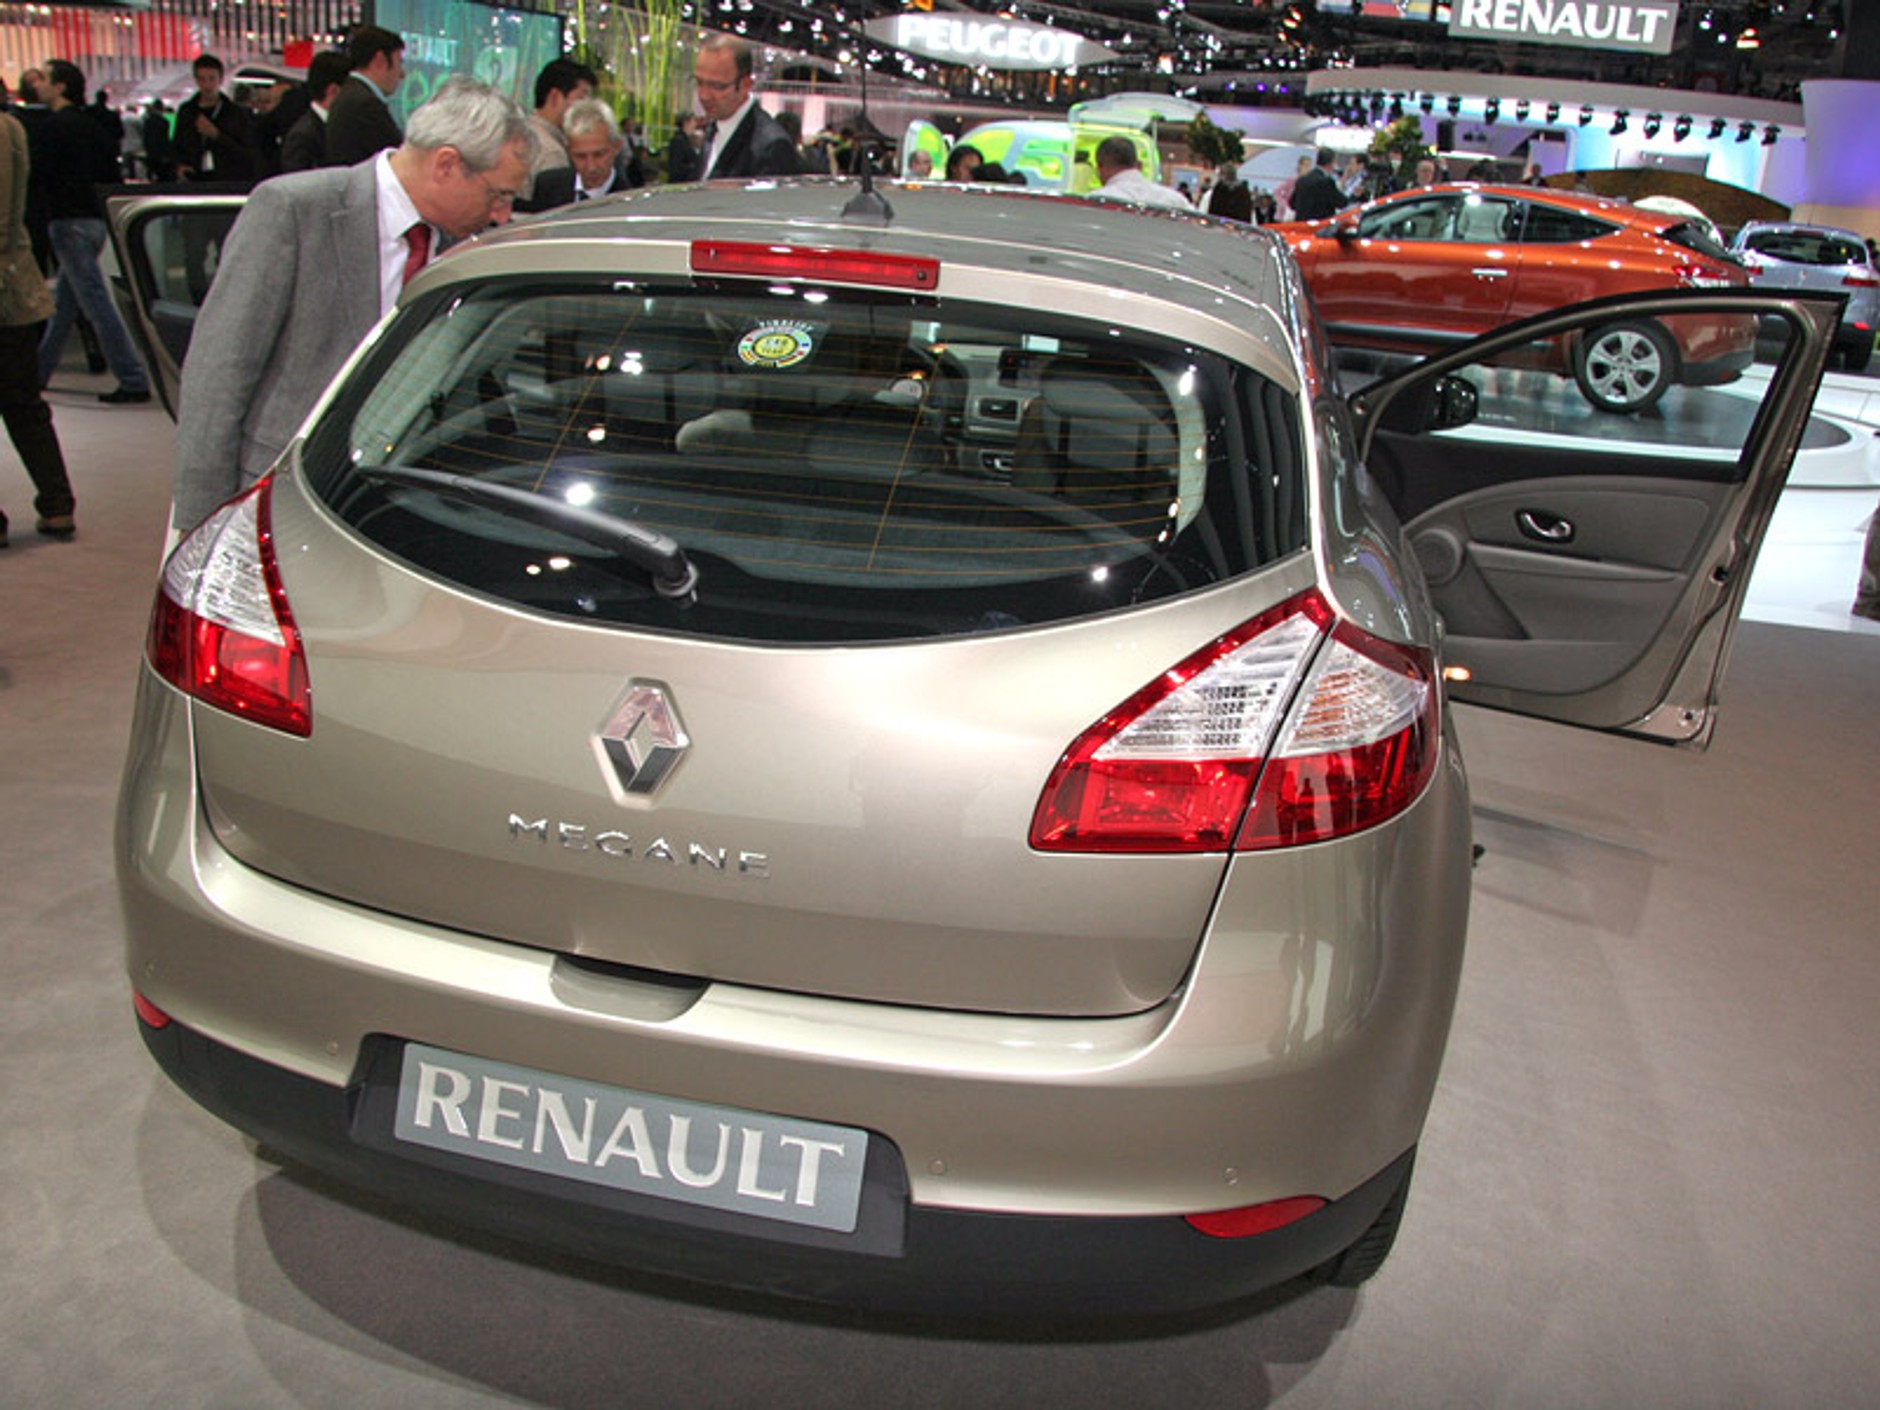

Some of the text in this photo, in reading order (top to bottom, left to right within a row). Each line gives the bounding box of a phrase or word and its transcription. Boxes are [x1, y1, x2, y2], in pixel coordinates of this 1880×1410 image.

[897, 14, 1084, 65] PEUGEOT
[1459, 0, 1669, 44] RENAULT
[508, 812, 770, 879] MEGANE
[413, 1061, 845, 1207] RENAULT
